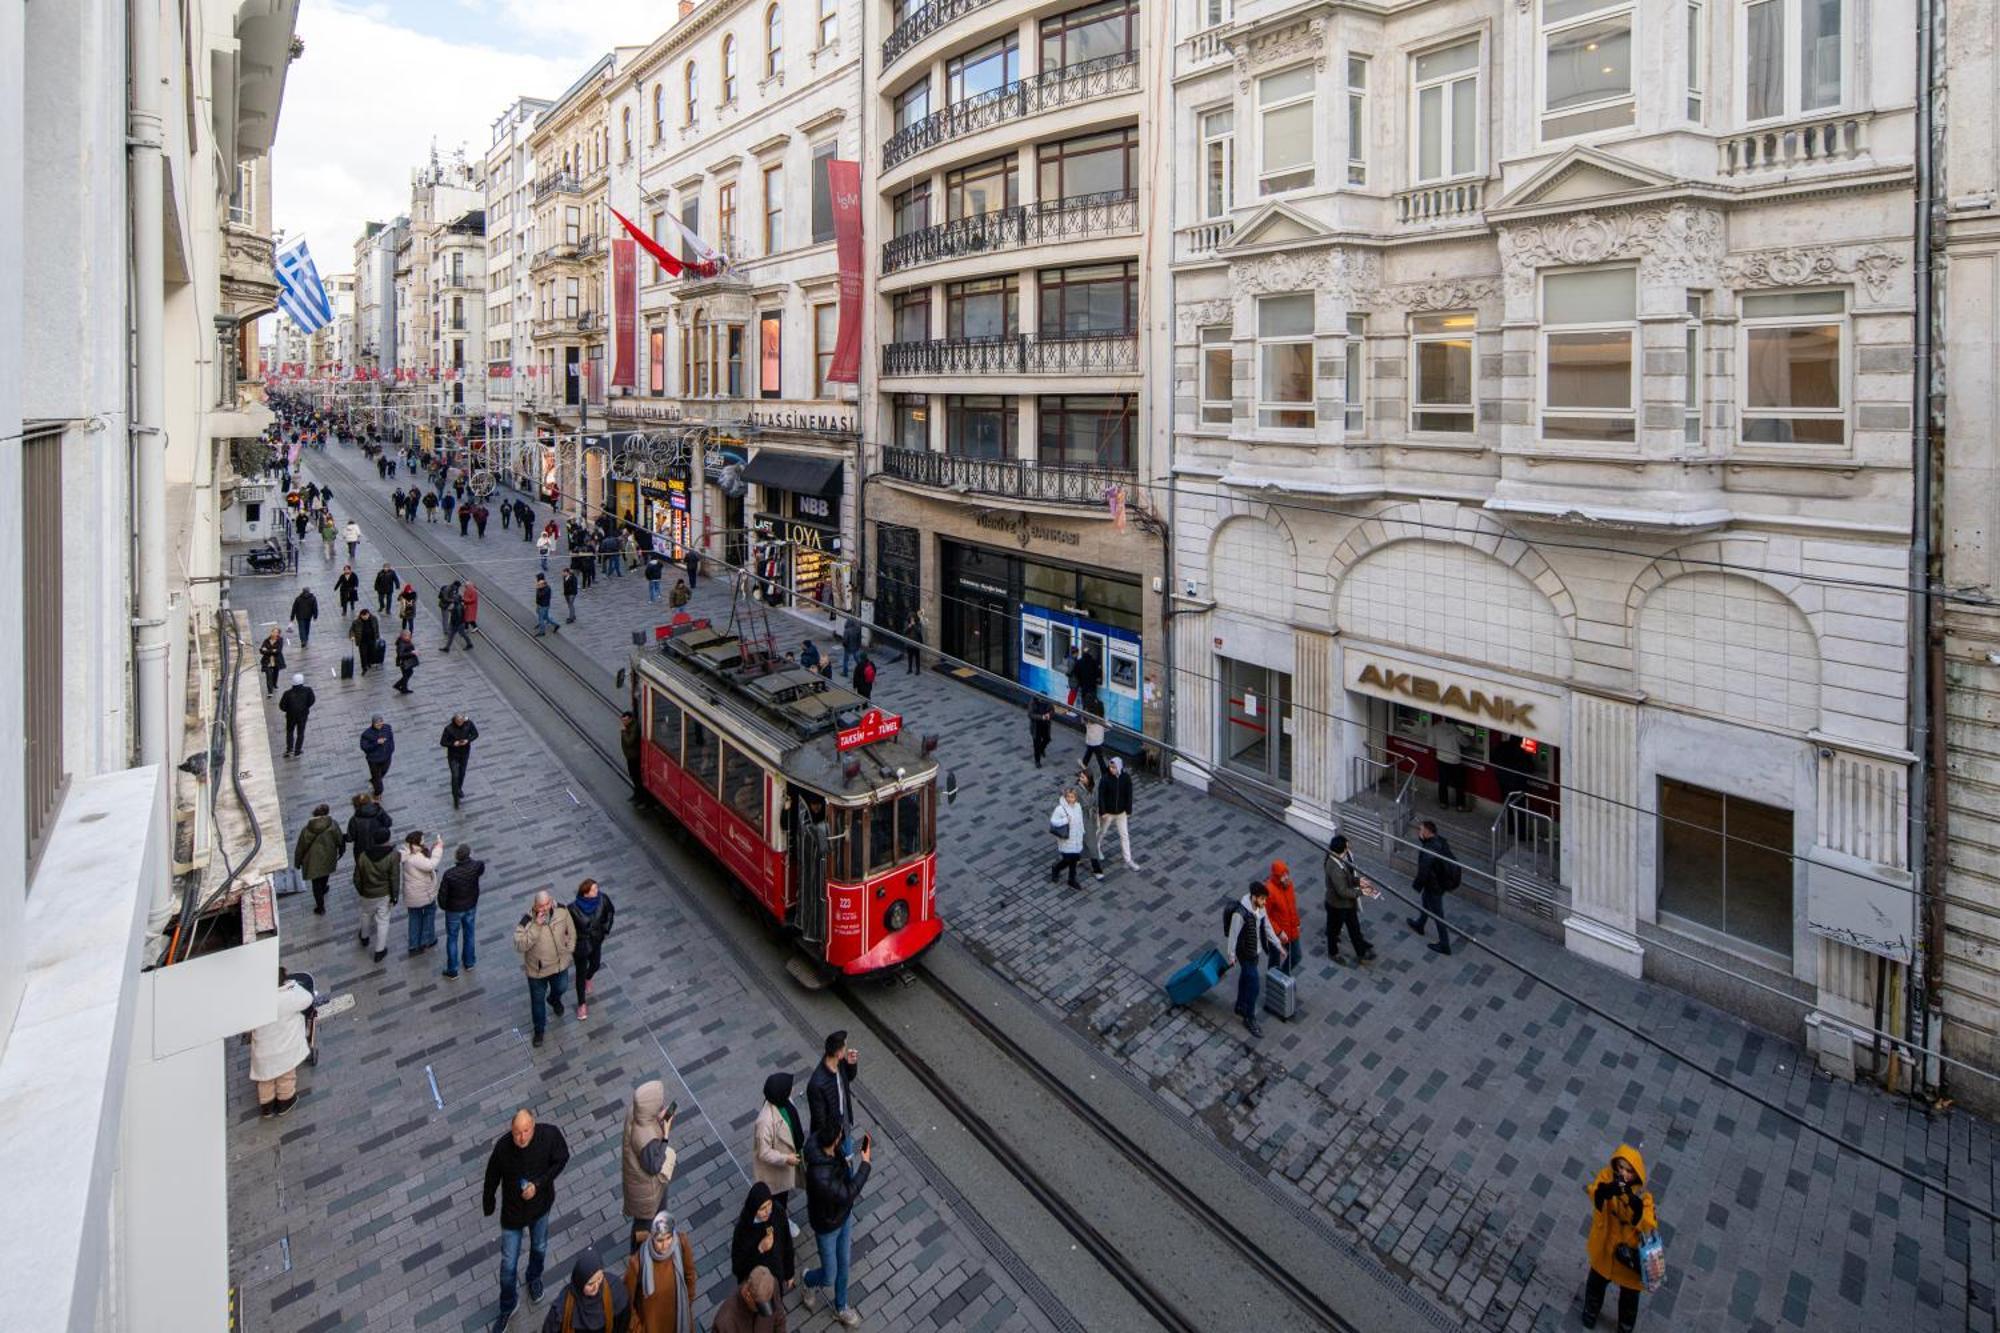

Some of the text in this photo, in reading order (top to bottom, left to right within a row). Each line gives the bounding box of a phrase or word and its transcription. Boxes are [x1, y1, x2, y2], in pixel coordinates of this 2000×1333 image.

[746, 410, 854, 433] ATLAS SİNEMASI
[801, 496, 829, 517] NBB
[1031, 526, 1080, 546] BANKASI
[1358, 664, 1537, 730] AKBANK
[868, 712, 876, 725] 2
[878, 720, 898, 735] TÜNEL
